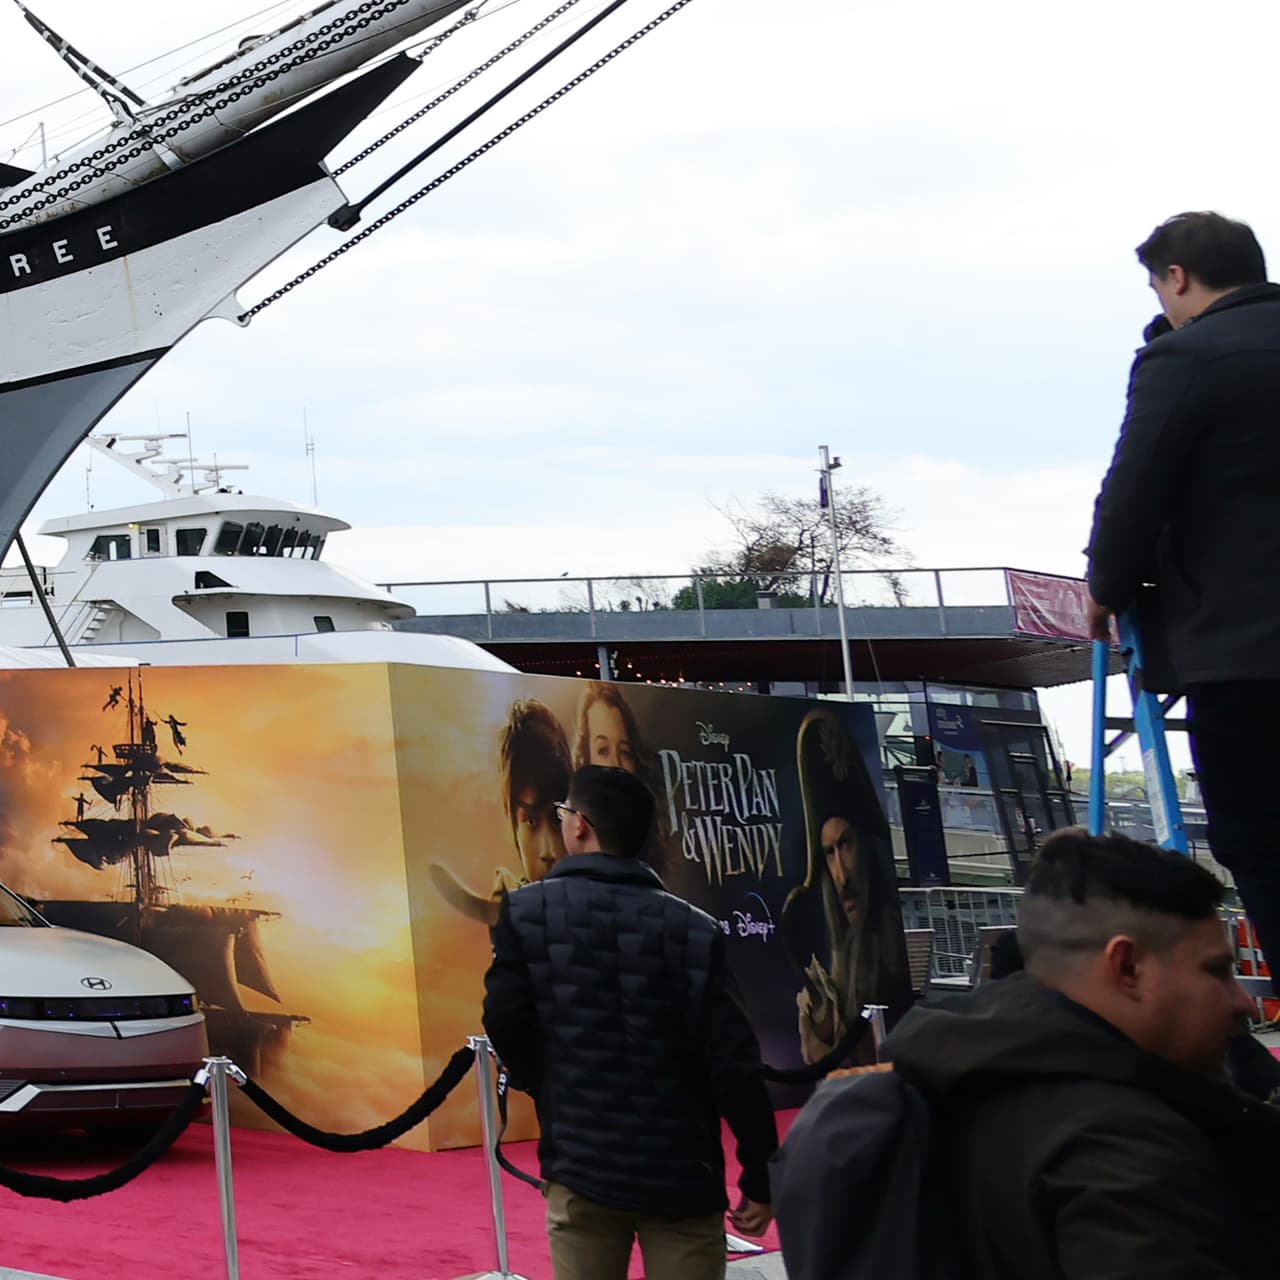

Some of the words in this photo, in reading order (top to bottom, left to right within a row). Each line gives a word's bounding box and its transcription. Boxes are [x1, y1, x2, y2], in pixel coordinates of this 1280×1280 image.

[696, 721, 730, 751] Disney
[658, 749, 747, 836] PETER
[733, 753, 781, 820] PAN
[693, 816, 784, 887] WENDY
[732, 911, 776, 942] Disney+
